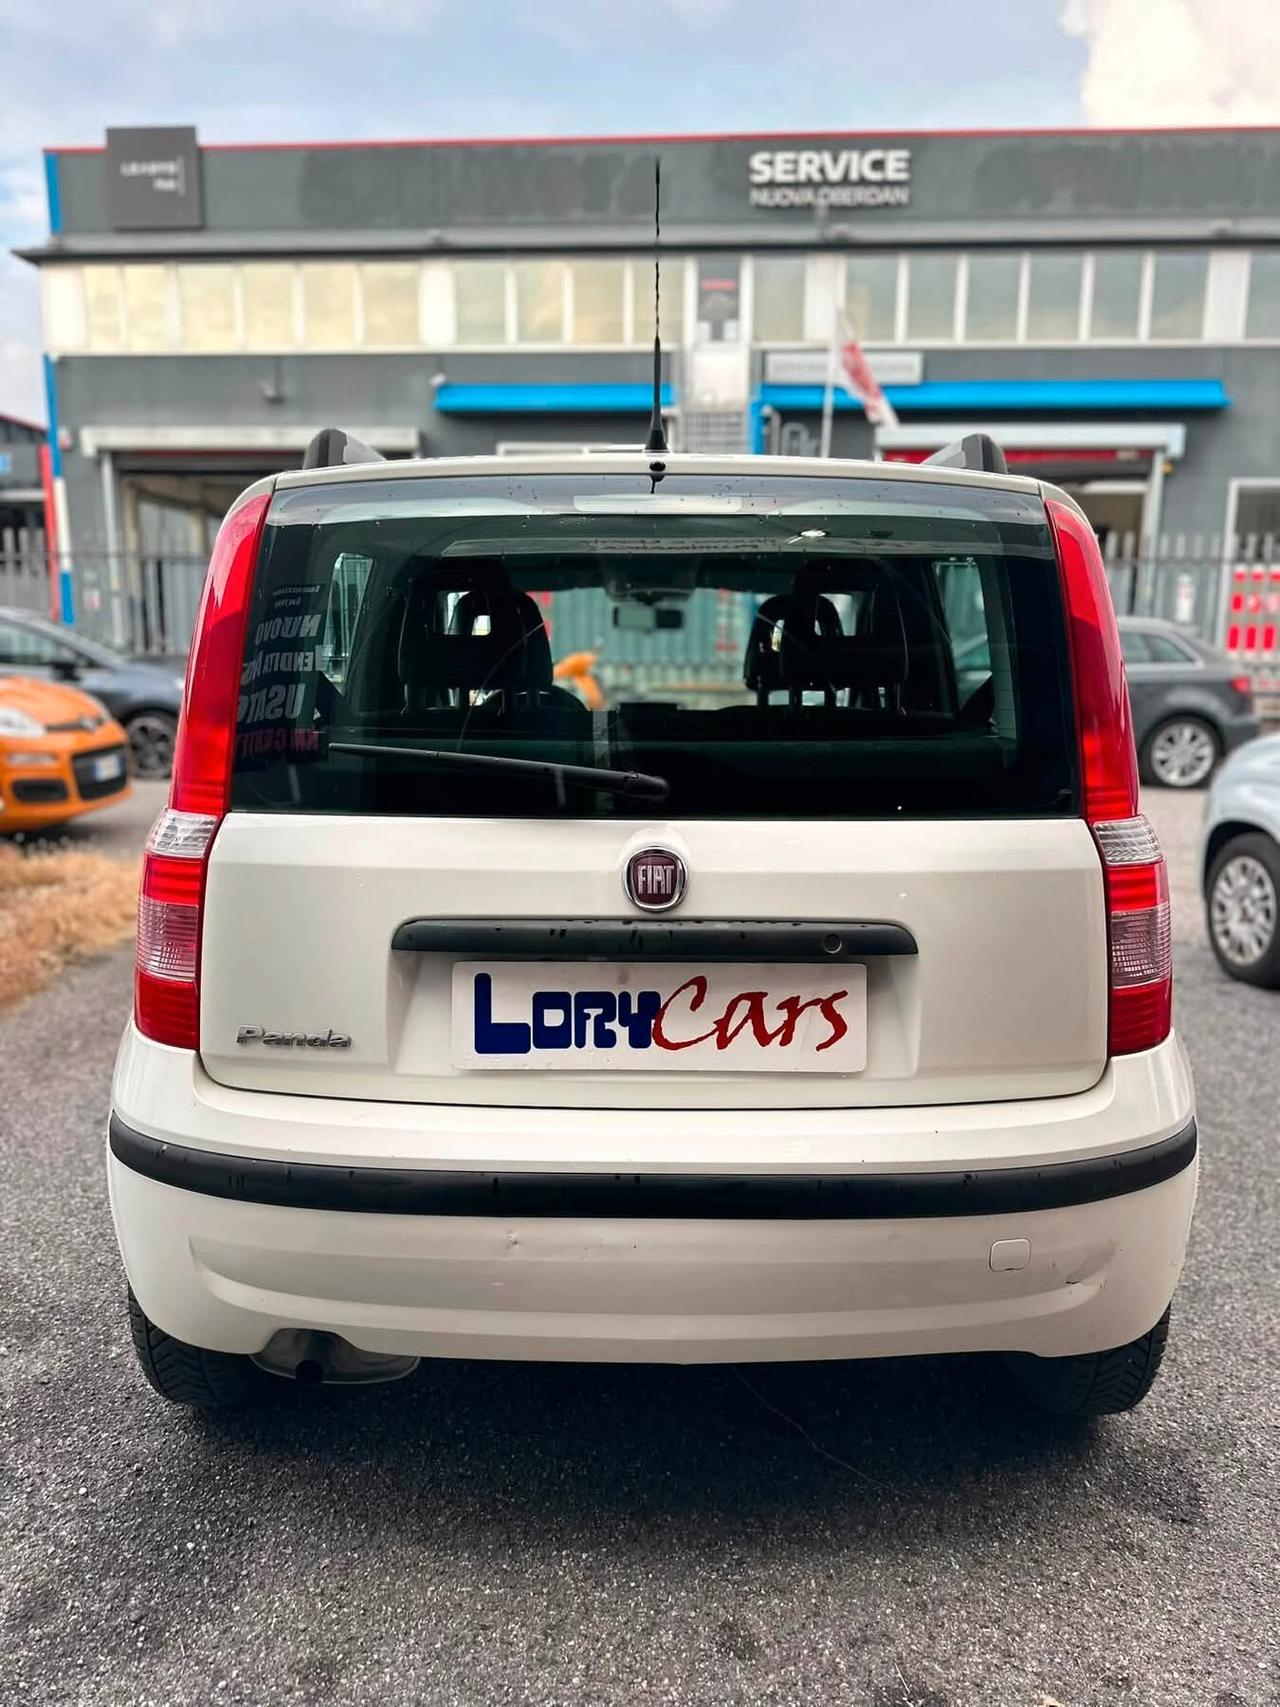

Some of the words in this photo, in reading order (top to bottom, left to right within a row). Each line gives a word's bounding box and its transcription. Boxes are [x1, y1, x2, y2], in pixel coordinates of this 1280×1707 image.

[750, 150, 911, 183] SERVICE
[751, 186, 816, 207] NUOVA
[637, 865, 675, 894] FIAT
[236, 1024, 352, 1048] Panda
